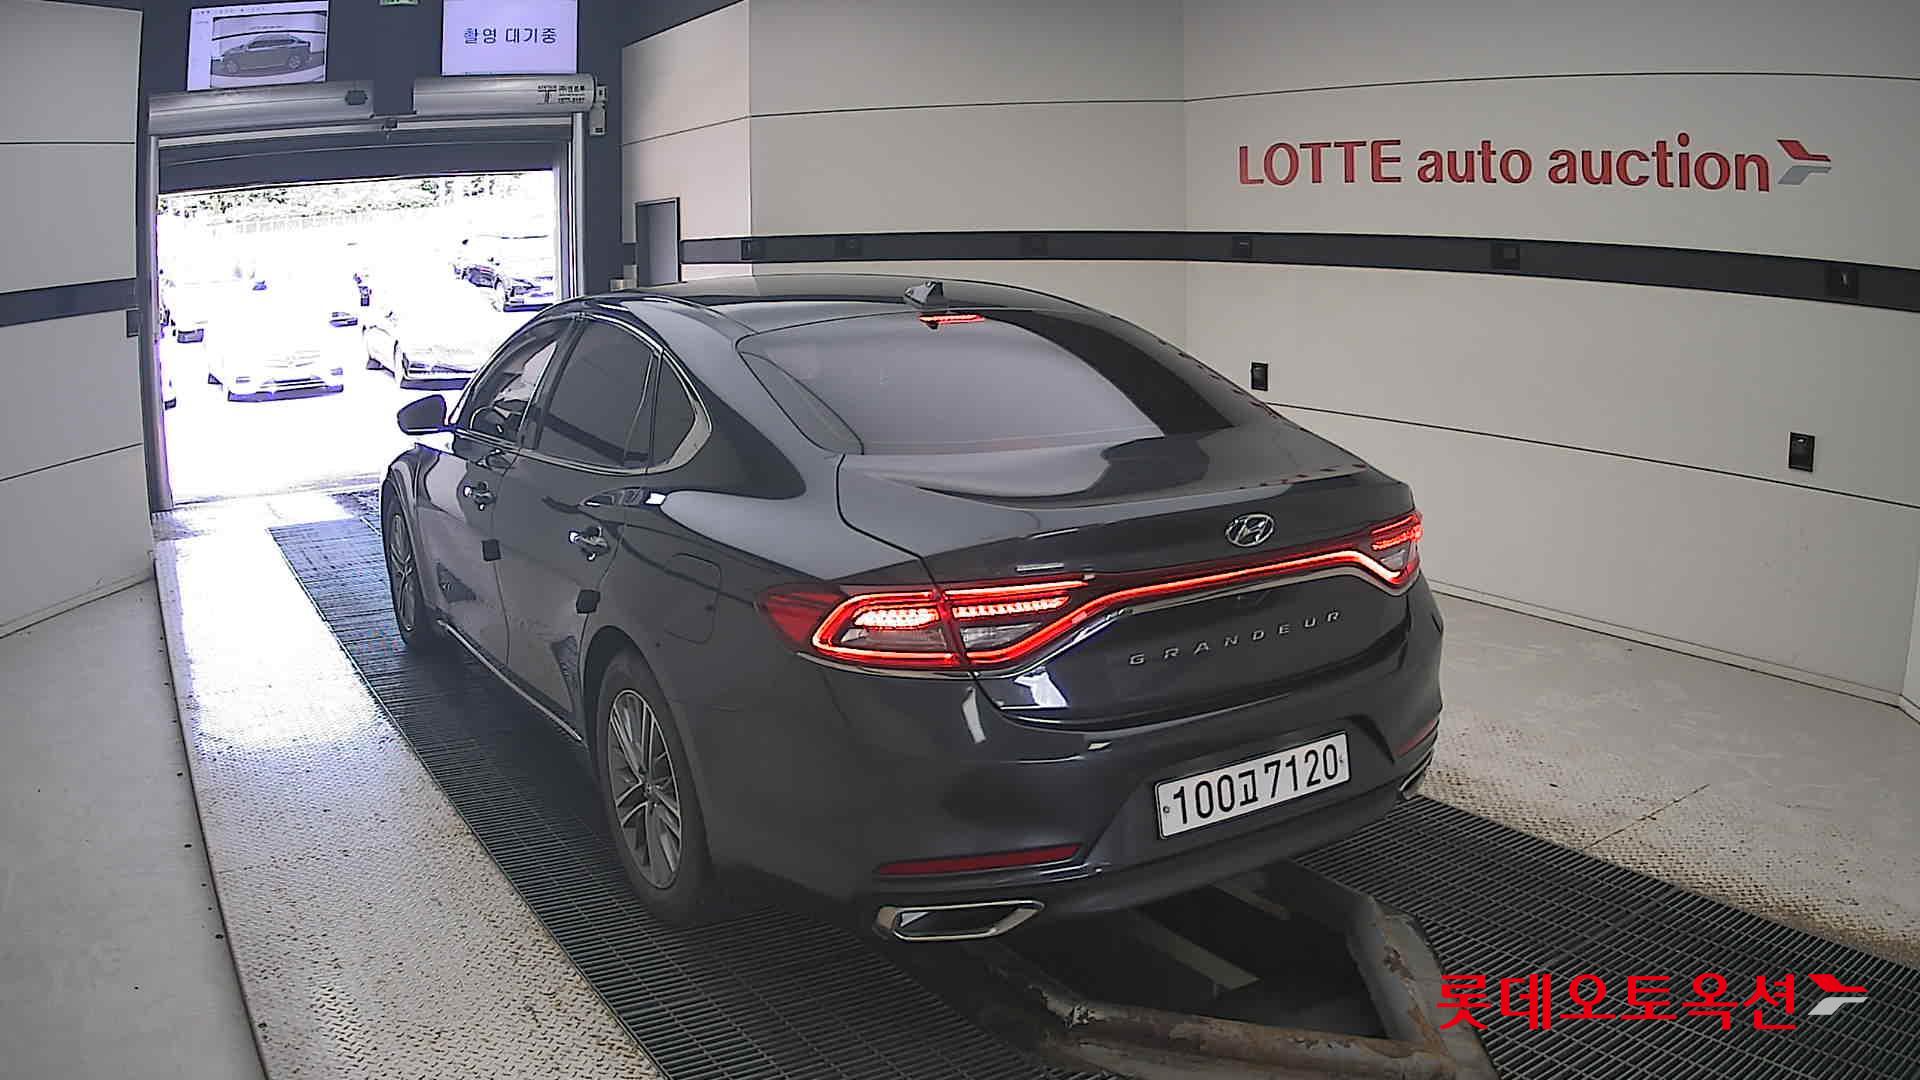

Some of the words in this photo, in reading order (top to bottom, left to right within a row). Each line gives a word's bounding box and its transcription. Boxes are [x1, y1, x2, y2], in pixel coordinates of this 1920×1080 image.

[463, 27, 497, 45] 촬영
[505, 27, 557, 45] 대기중
[1238, 139, 1401, 185] LOTTE
[1416, 140, 1532, 184] auto
[1548, 131, 1770, 192] auction
[1128, 610, 1340, 666] GRANDEUR
[1172, 743, 1339, 825] 100고7120
